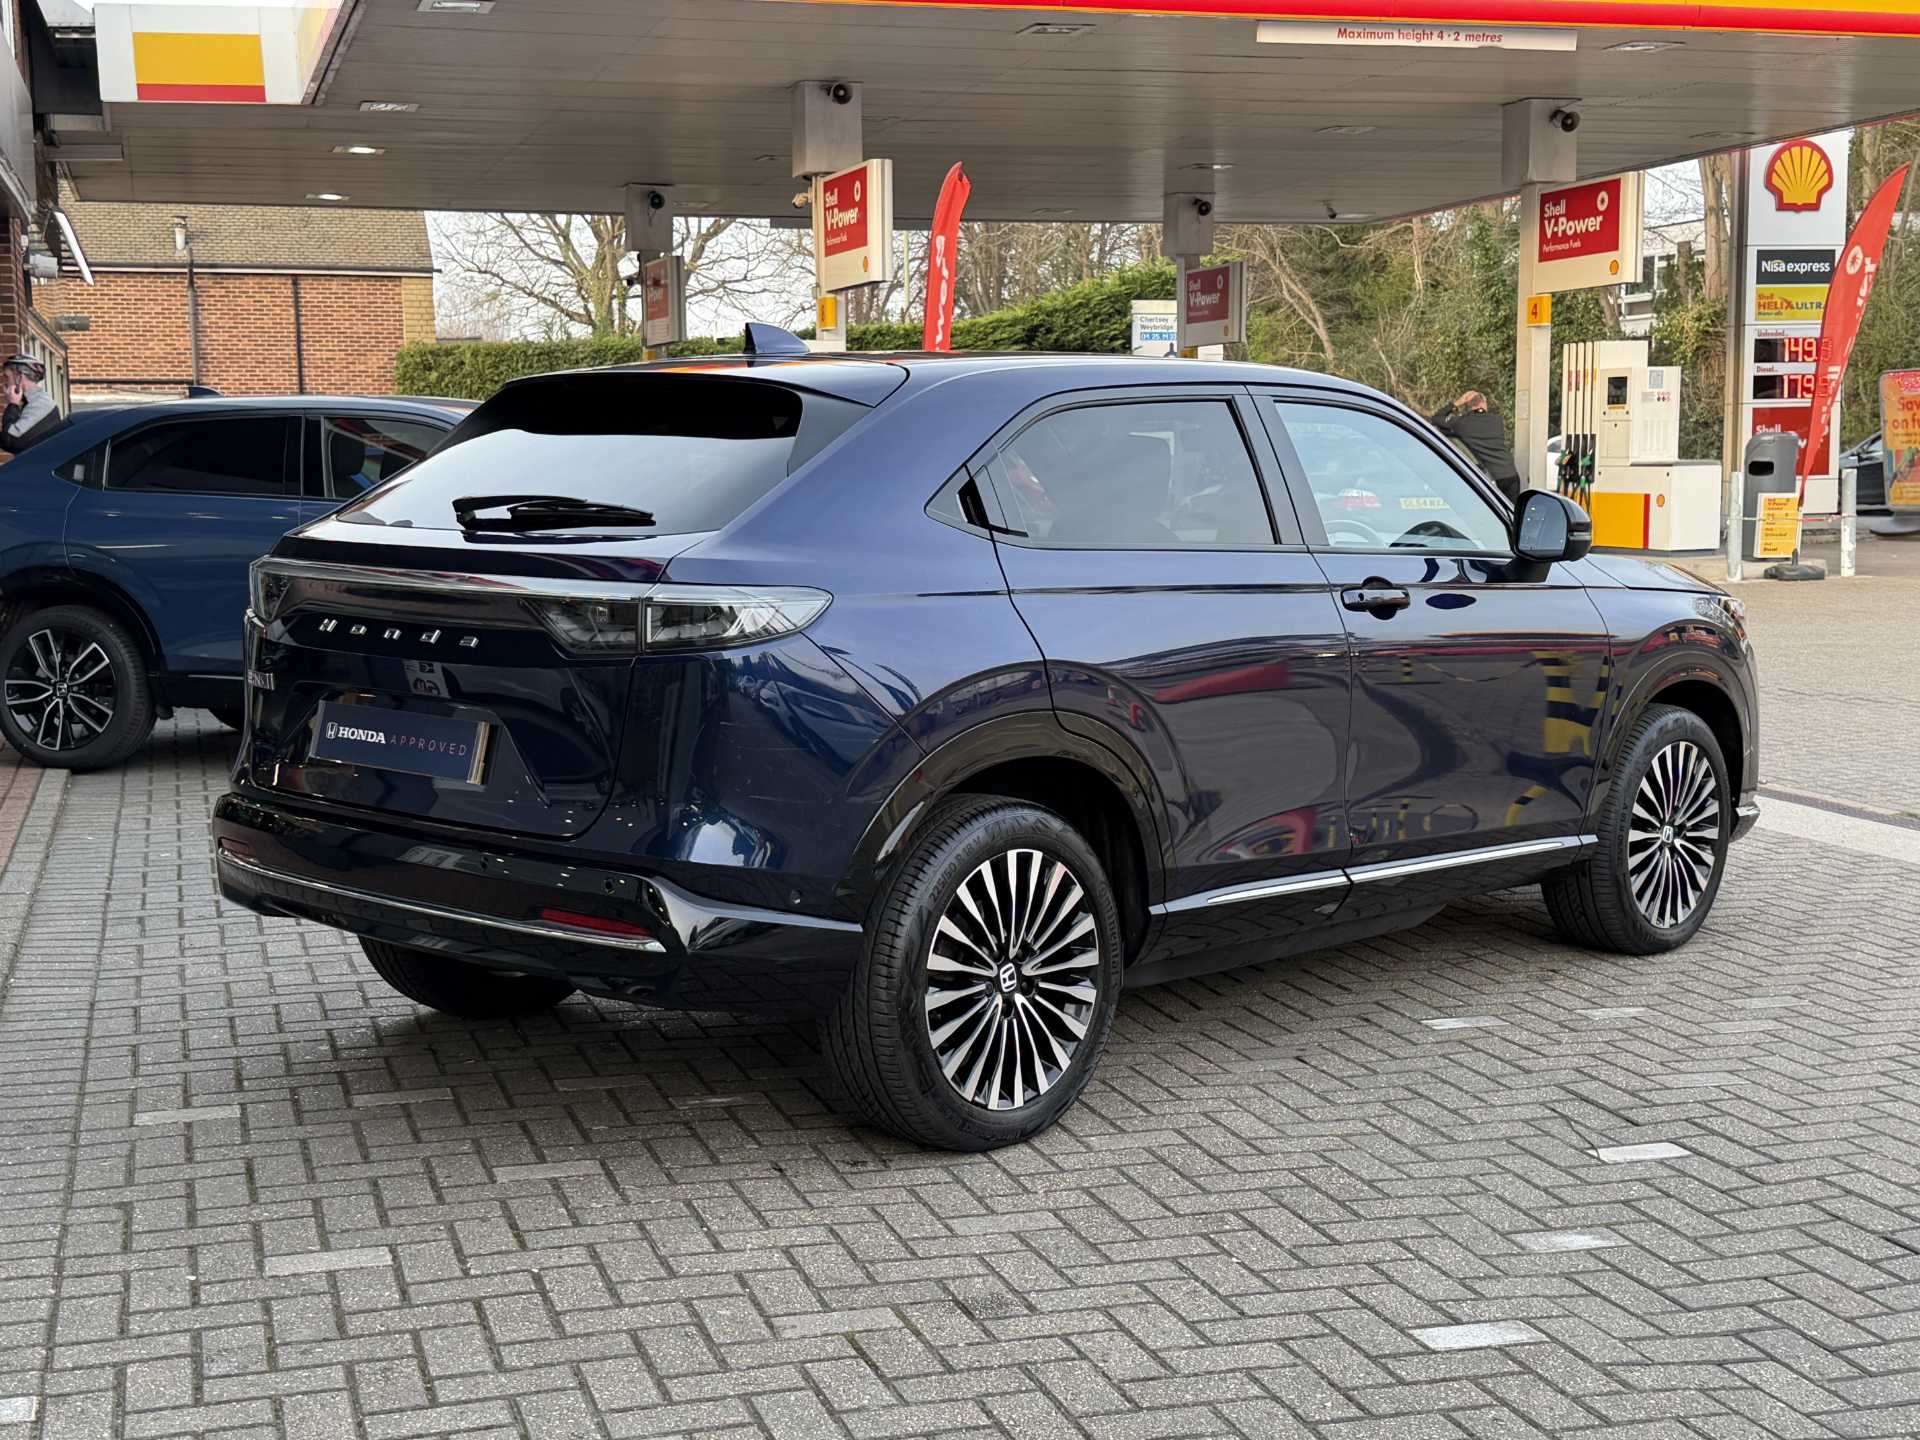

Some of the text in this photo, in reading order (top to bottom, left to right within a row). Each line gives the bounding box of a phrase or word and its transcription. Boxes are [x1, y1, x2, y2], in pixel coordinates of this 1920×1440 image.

[1337, 27, 1394, 40] Maximum
[1398, 29, 1434, 43] height
[1465, 32, 1503, 43] metres
[825, 188, 838, 208] Shell
[1544, 199, 1566, 218] Shell
[825, 207, 859, 231] V-Power
[1544, 215, 1603, 239] V-Power
[1761, 260, 1831, 274] Nisa express
[1189, 293, 1221, 307] V-Power
[1757, 299, 1825, 311] HELIX ULTR
[1530, 303, 1538, 320] 4
[337, 726, 468, 757] HONDA APPROVED
